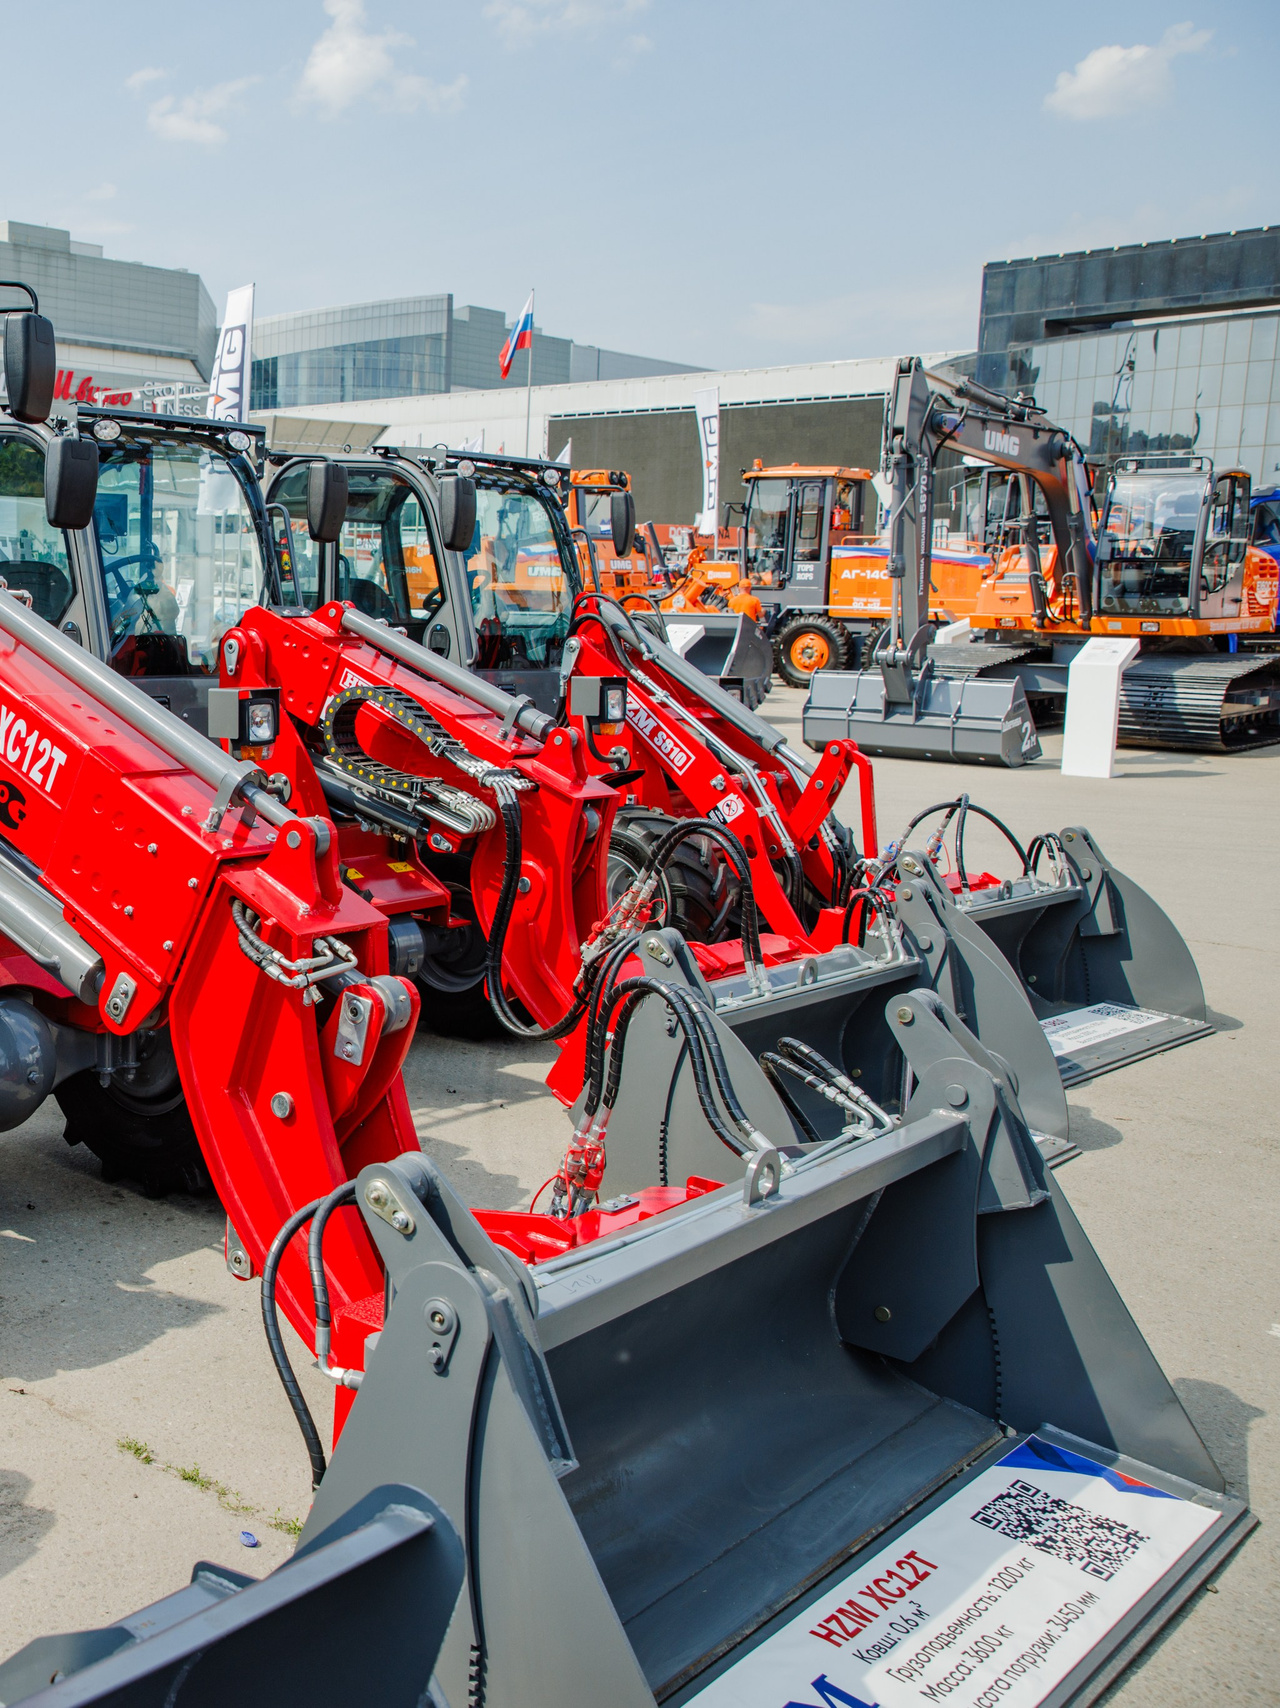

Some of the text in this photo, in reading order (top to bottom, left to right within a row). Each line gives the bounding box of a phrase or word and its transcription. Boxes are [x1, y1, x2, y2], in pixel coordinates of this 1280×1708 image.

[142, 381, 202, 402] CROUS
[215, 328, 243, 421] MG
[984, 430, 1020, 456] UMG
[919, 474, 928, 513] 5670
[610, 559, 633, 570] UMG
[625, 694, 688, 768] ZM S810
[809, 1549, 939, 1648] HZM XC12T
[885, 1556, 1036, 1683] Грузоподъемность: 1200 кг
[852, 1632, 902, 1665] Ковш:
[889, 1615, 919, 1635] 0.6
[919, 1624, 1015, 1704] Масса: 3600 кг
[1002, 1629, 1062, 1682] погрузки:
[1046, 1602, 1085, 1633] 3450
[1076, 1590, 1101, 1608] мм
